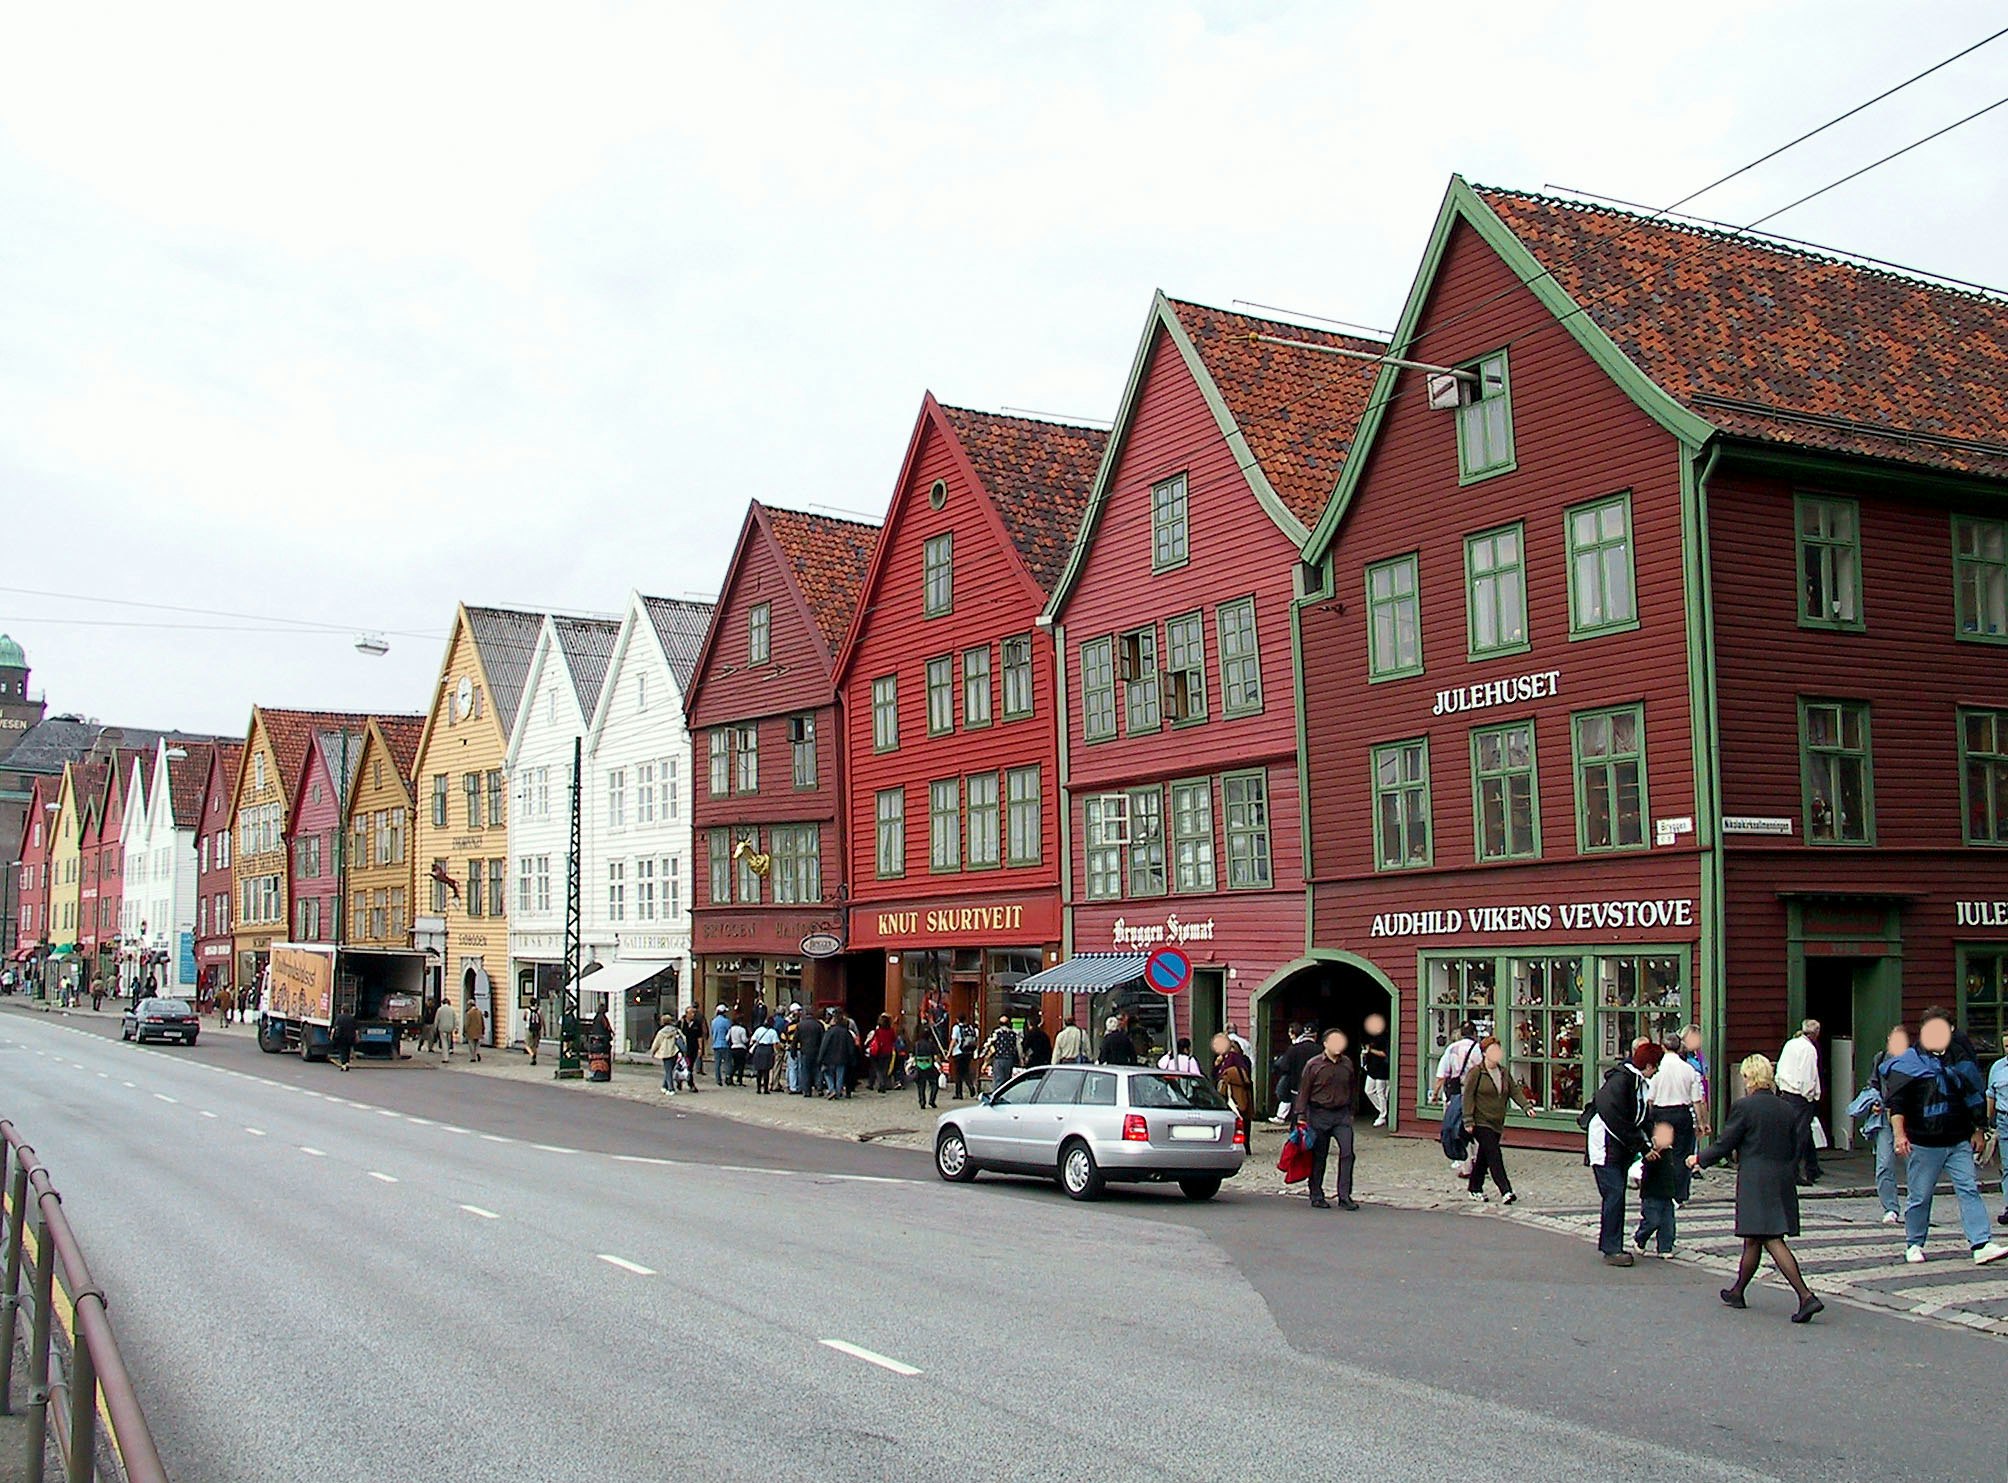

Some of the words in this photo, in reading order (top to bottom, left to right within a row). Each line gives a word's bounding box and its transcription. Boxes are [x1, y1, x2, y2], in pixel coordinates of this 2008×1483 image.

[1432, 670, 1560, 716] JULEHUSET
[878, 911, 918, 935] KNUT
[926, 905, 1023, 932] SKURTVEIT
[1370, 909, 1463, 938] AUDHILD
[1467, 903, 1553, 932] VIKENS
[1558, 899, 1693, 929] VEVSTOVE
[1956, 901, 2008, 925] JULE
[1112, 917, 1164, 951] Bryggen
